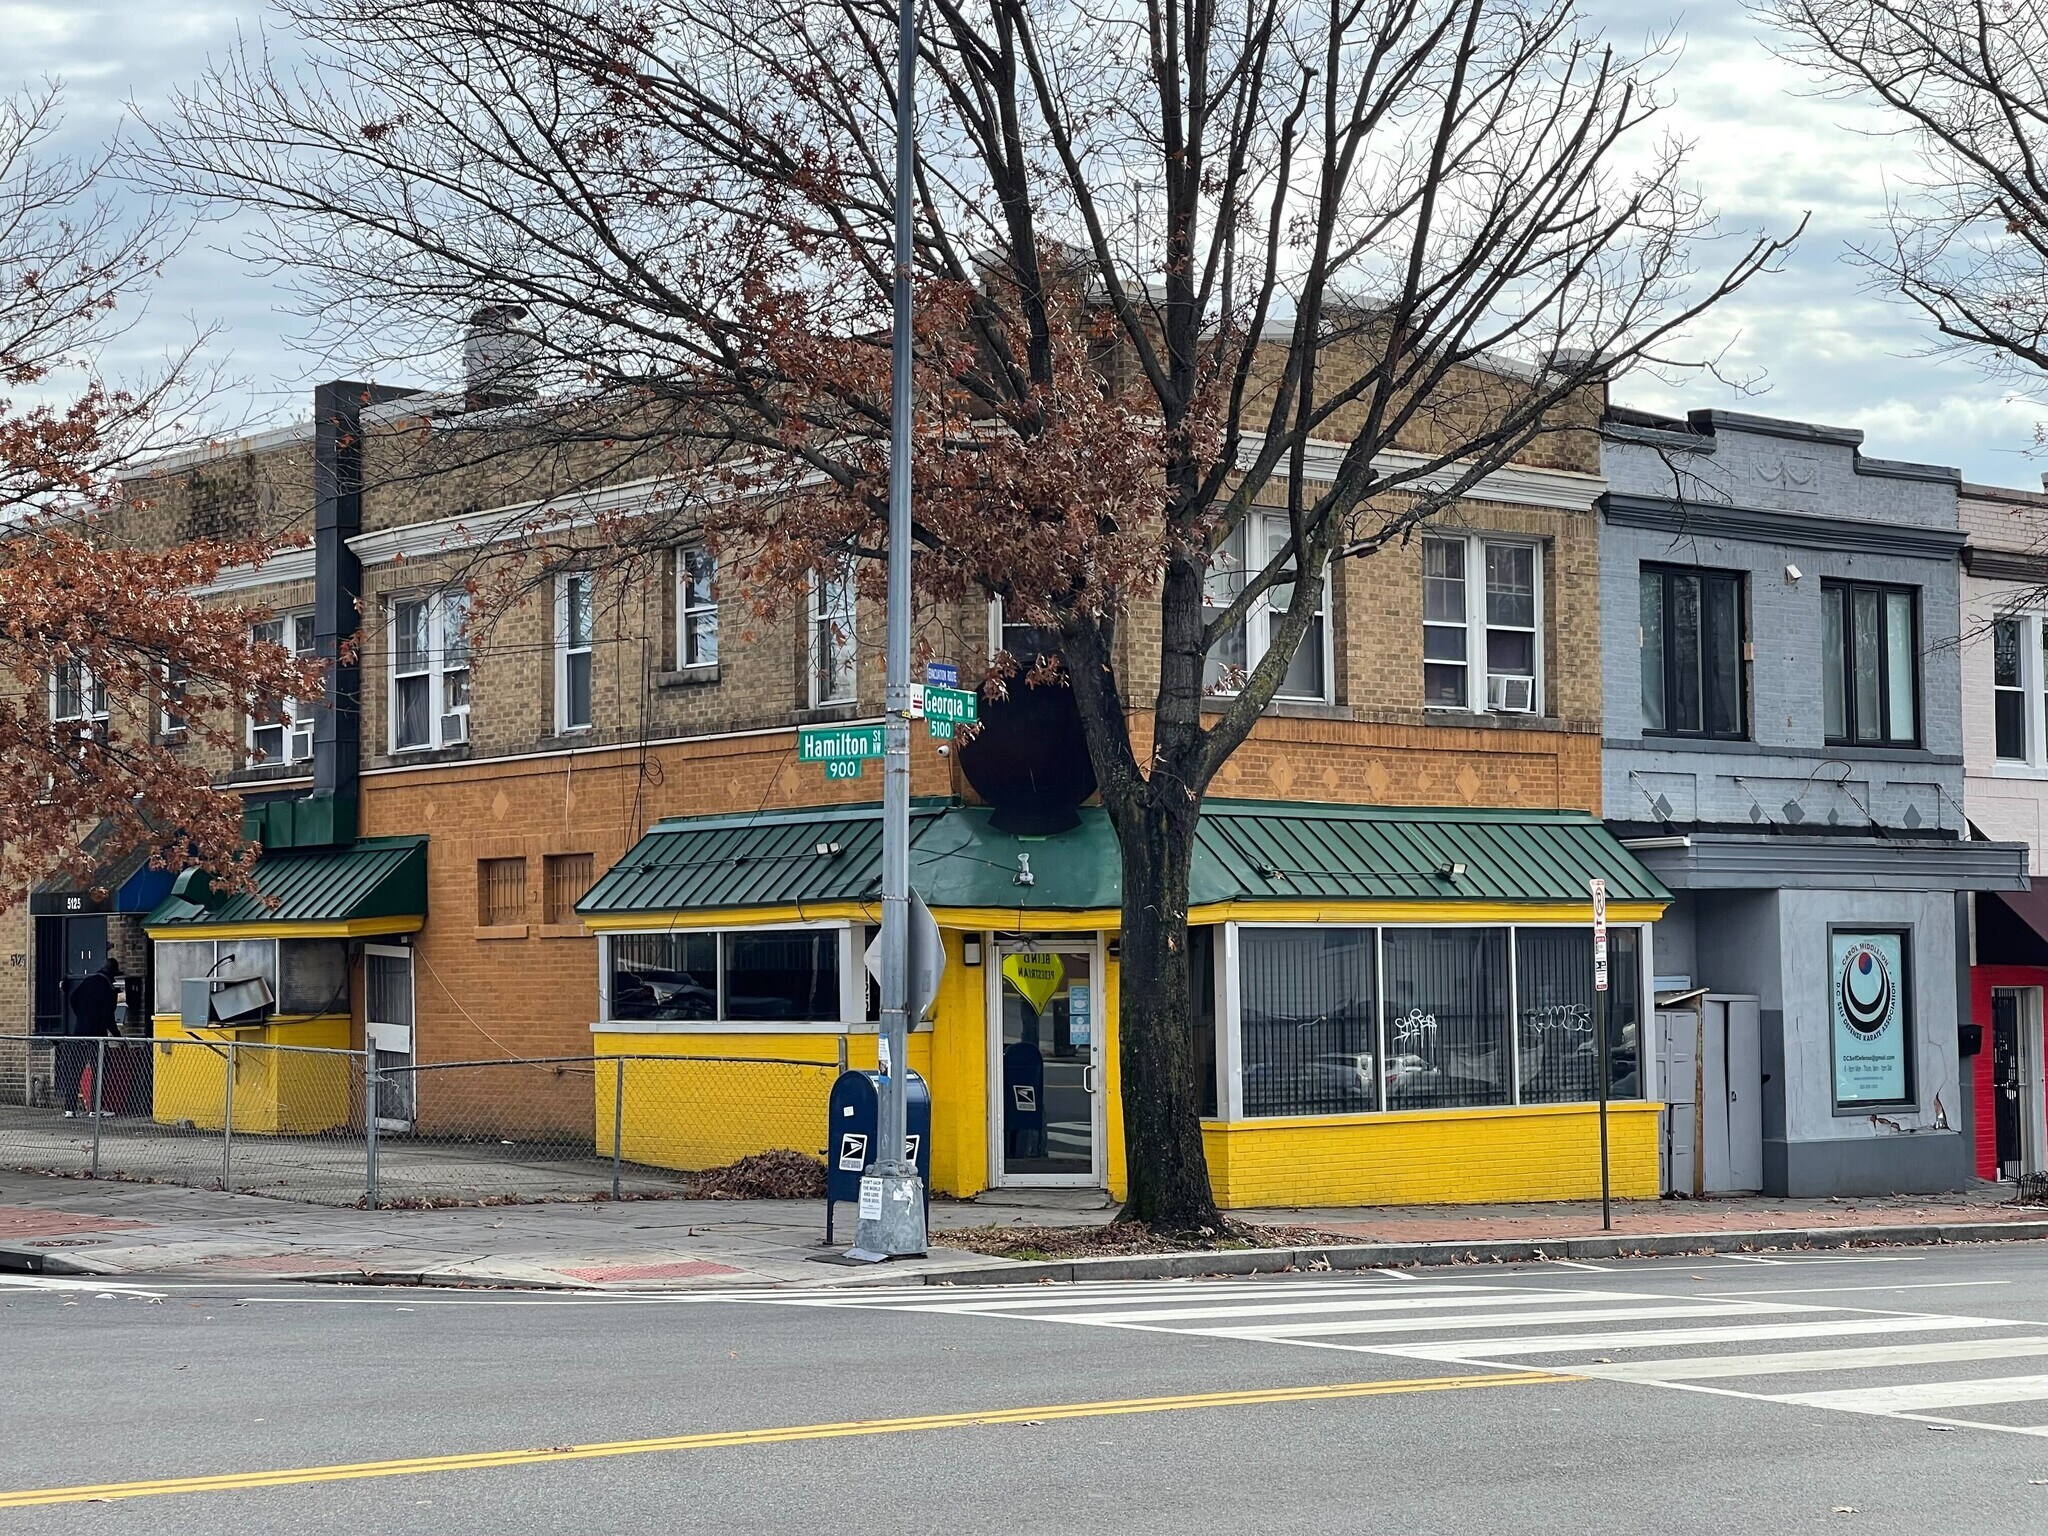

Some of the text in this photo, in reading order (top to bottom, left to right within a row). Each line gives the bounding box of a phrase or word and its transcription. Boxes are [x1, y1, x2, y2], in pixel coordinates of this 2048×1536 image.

[947, 671, 958, 683] ROUTE
[924, 689, 963, 721] Georgia
[967, 706, 974, 719] NW
[931, 720, 951, 738] 5100
[804, 729, 882, 758] Hamilton St NW
[829, 761, 856, 778] 900
[67, 897, 81, 909] 5125
[1841, 943, 1890, 967] CAROL MIDDLETON
[1837, 1001, 1845, 1018] SELF
[1842, 1019, 1862, 1042] DEFENSE
[1862, 1030, 1882, 1042] KARATE
[1882, 982, 1896, 1033] ASSOCIATION
